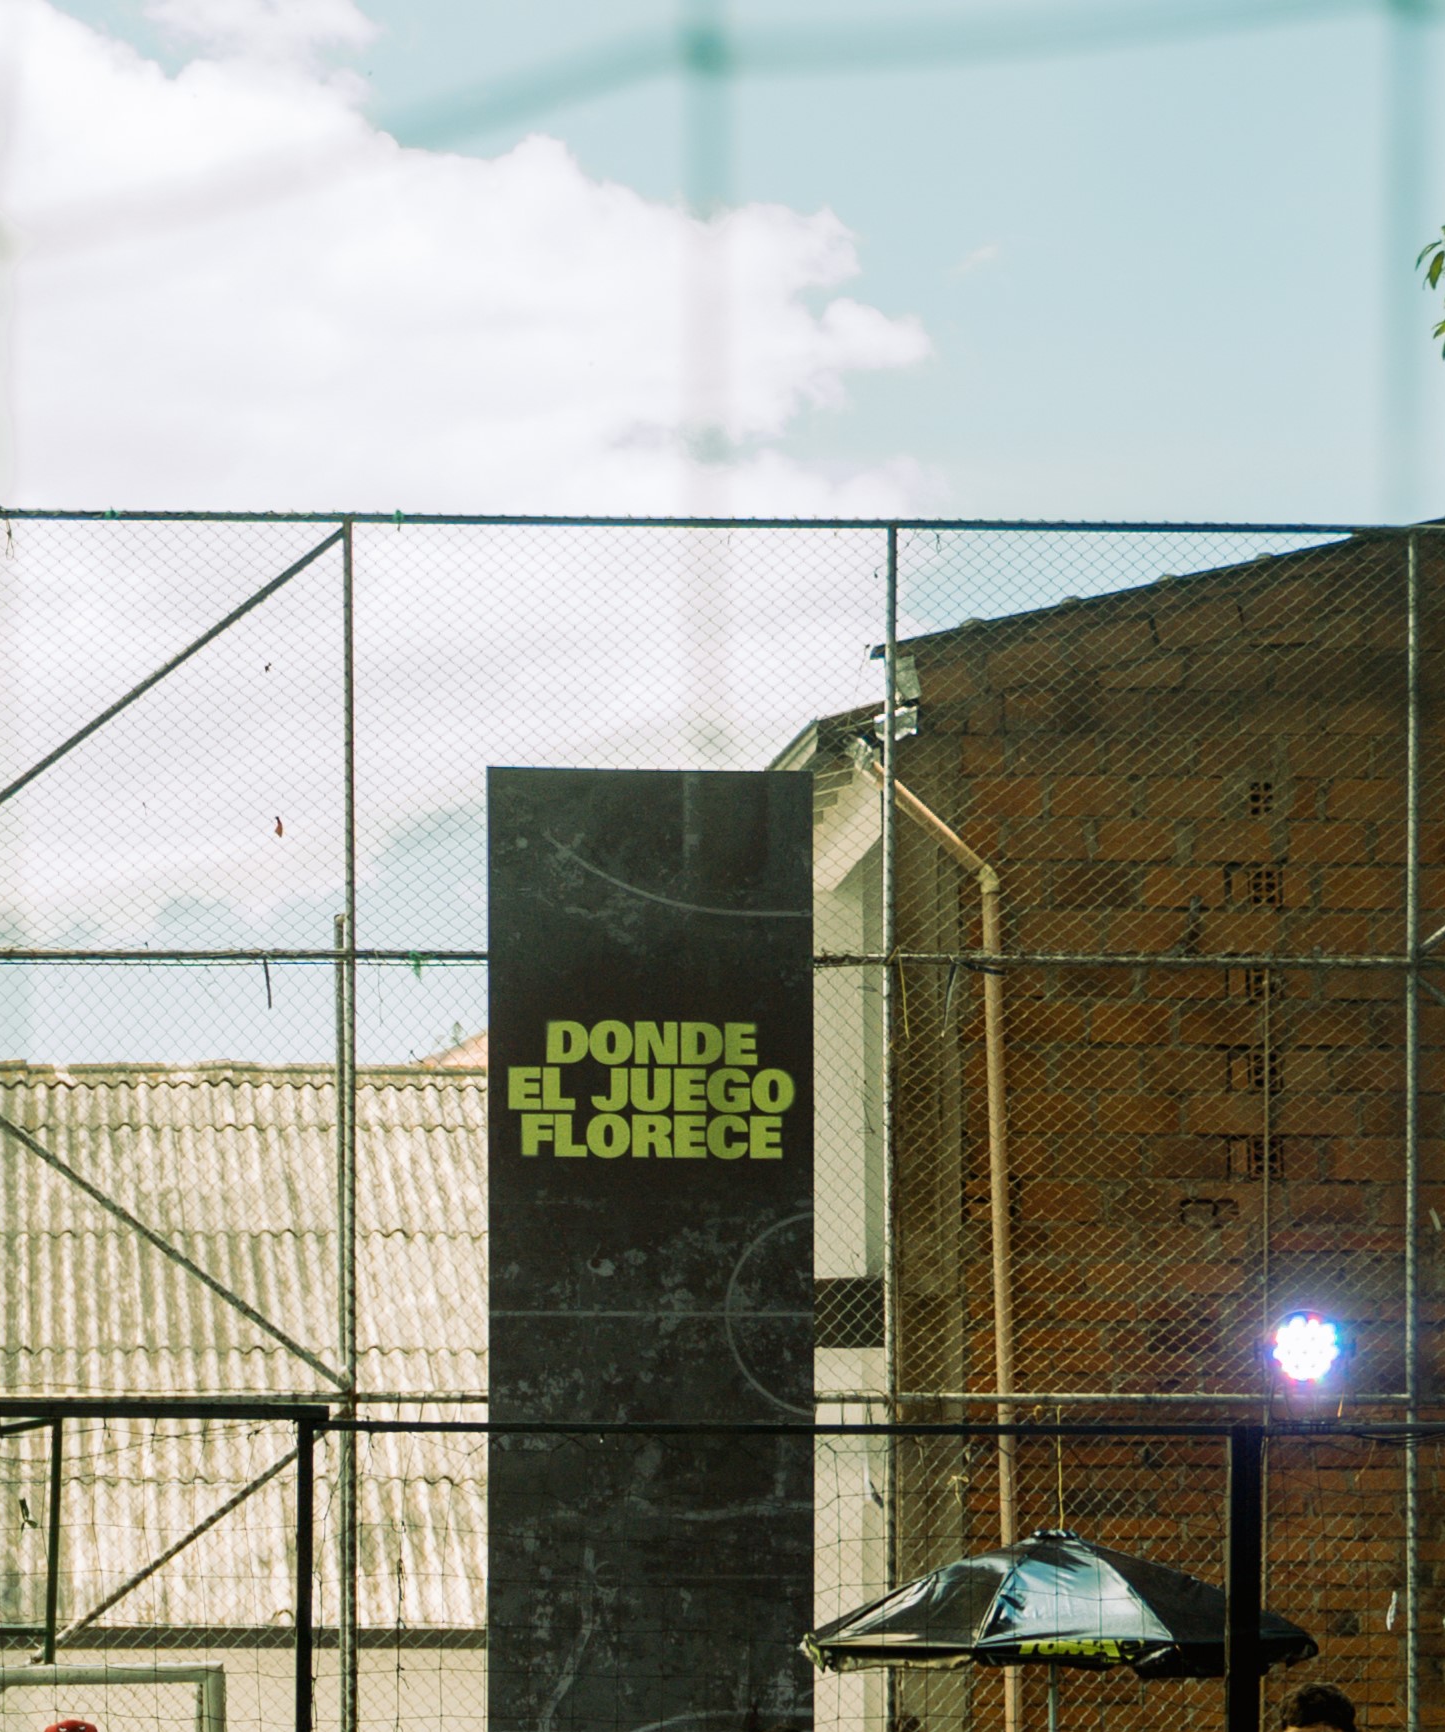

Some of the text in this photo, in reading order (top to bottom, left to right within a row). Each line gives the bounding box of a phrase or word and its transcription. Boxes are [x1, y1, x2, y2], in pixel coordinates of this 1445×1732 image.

[545, 1020, 758, 1065] DONDE
[506, 1066, 796, 1114] EL JUEGO
[520, 1113, 784, 1160] FLORECE
[1018, 1638, 1121, 1658] TOMA
